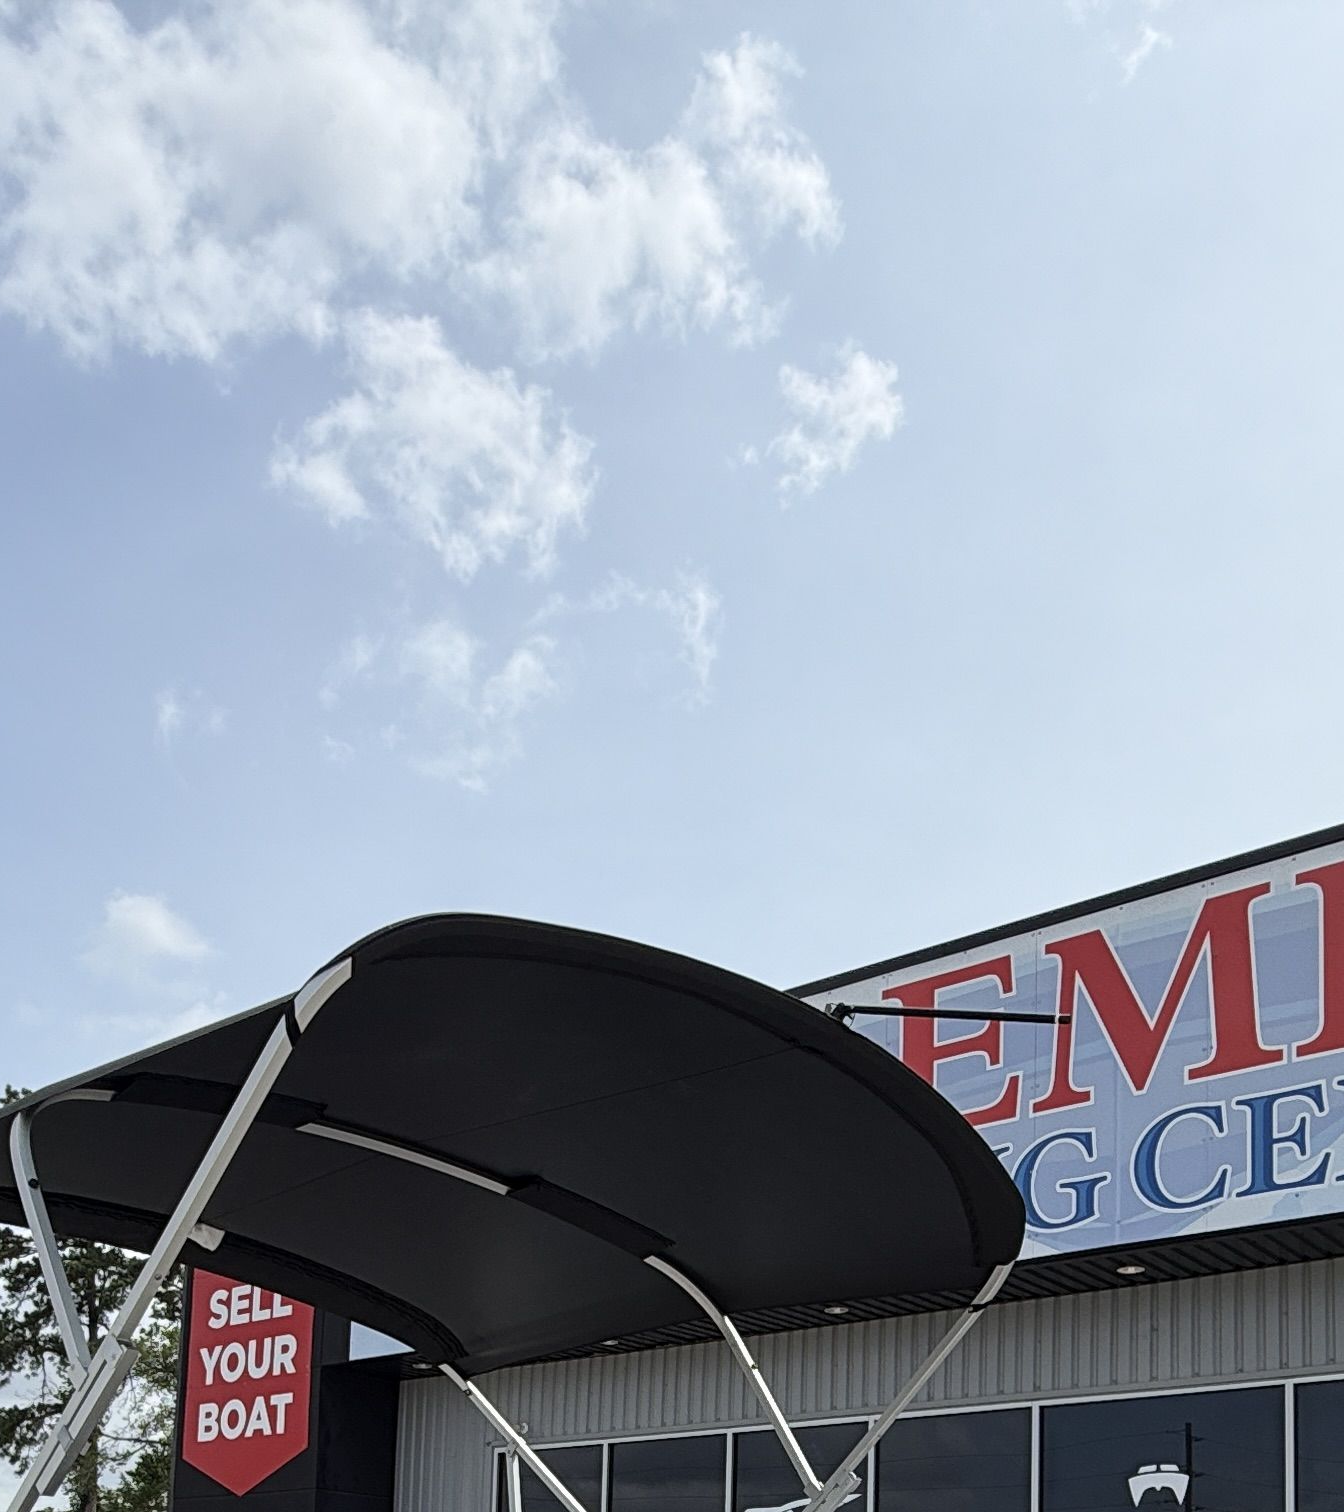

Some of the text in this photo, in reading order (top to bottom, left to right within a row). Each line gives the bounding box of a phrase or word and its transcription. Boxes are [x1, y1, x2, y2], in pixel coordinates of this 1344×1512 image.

[992, 1131, 1110, 1229] G
[208, 1285, 293, 1329] SELL
[200, 1334, 297, 1386] YOUR
[197, 1393, 293, 1442] BOAT
